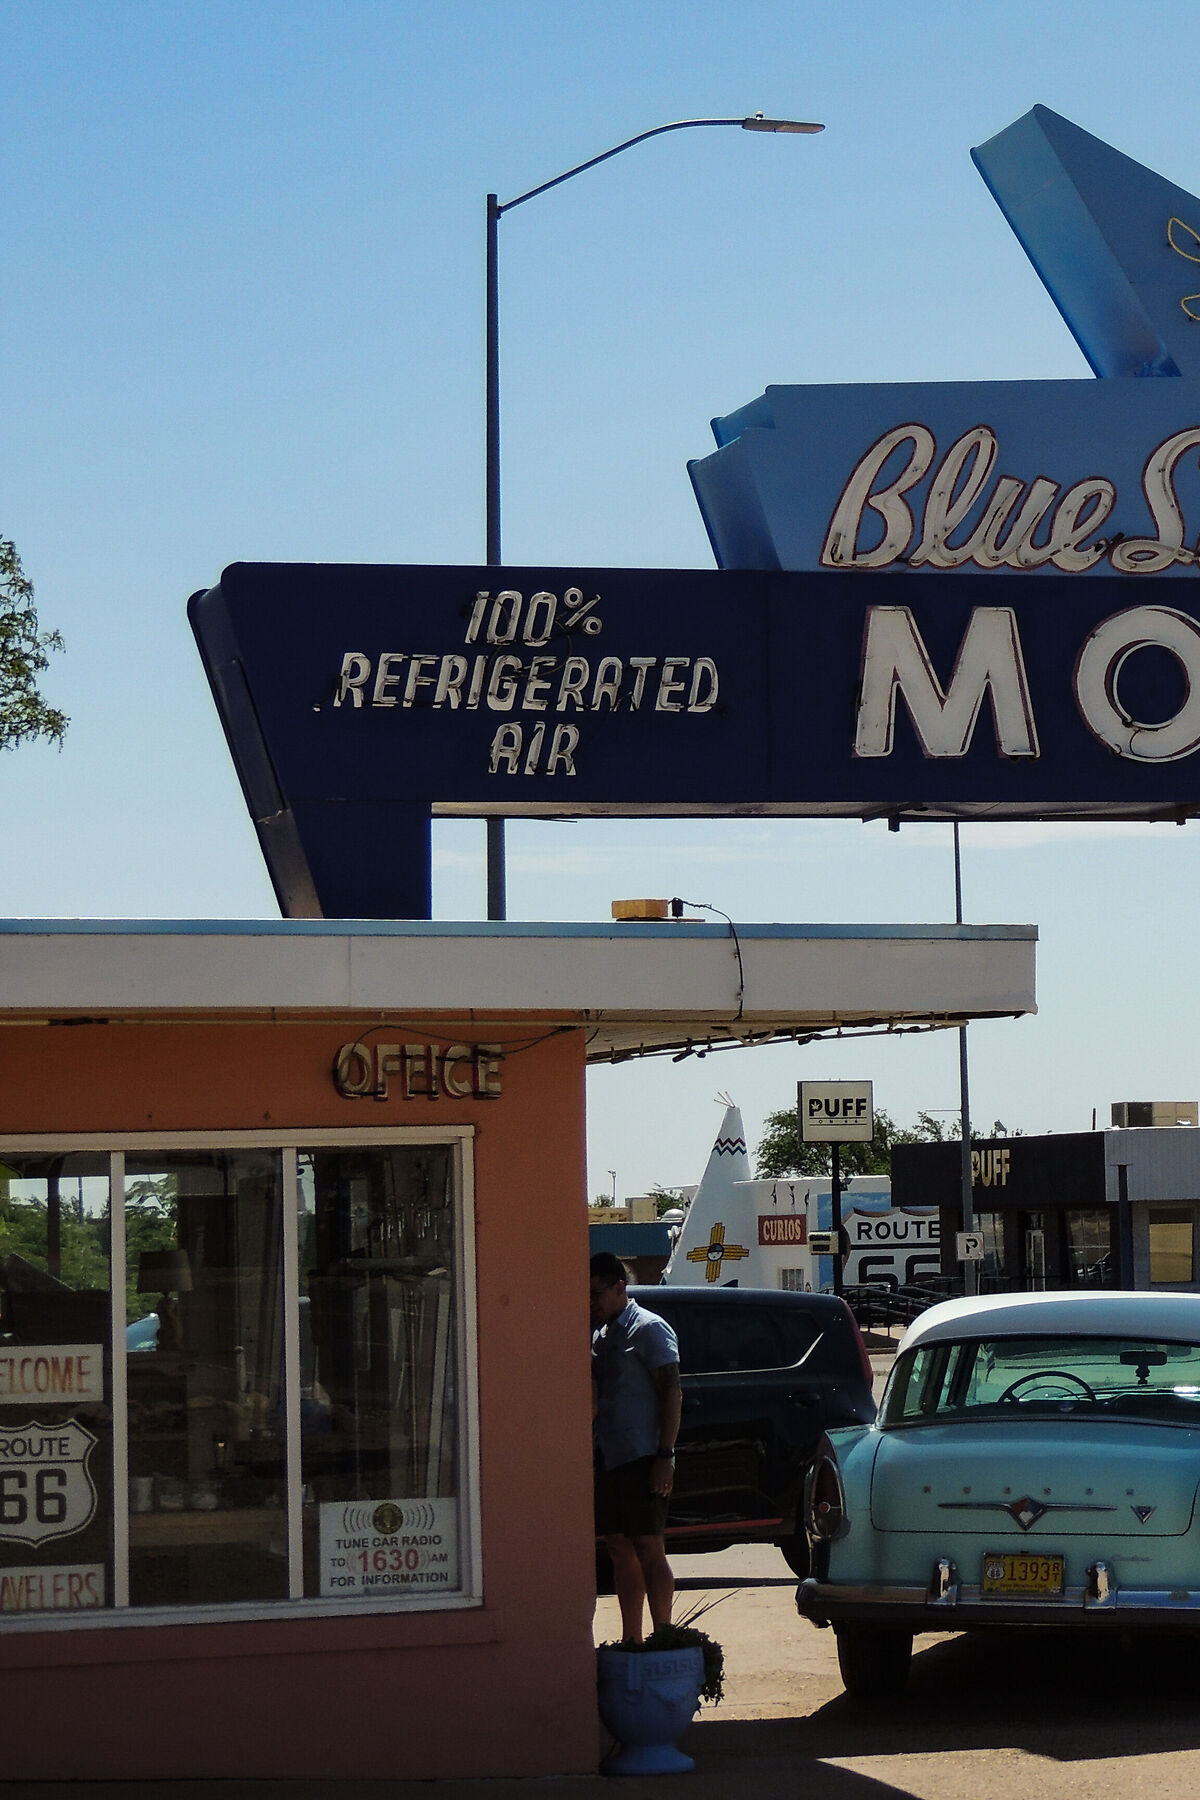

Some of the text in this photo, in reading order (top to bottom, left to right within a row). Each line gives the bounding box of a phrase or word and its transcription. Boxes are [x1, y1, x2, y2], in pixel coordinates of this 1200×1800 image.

[818, 422, 1118, 570] Blue
[464, 587, 603, 648] 100%
[332, 652, 720, 713] REFRIGERATED
[488, 721, 580, 776] AIR
[333, 1043, 504, 1101] OFFICE
[808, 1098, 867, 1117] PUFF
[971, 1149, 1010, 1187] PUFF
[763, 1218, 802, 1241] CURIOS
[857, 1220, 940, 1241] ROUTE
[0, 1436, 71, 1458] ROUTE
[0, 1468, 68, 1525] 66
[335, 1534, 443, 1549] TUNE CAR RADIO
[330, 1548, 449, 1572] TO 1630 AM
[1007, 1561, 1051, 1581] 1393
[330, 1572, 449, 1587] FOR INFORMATION
